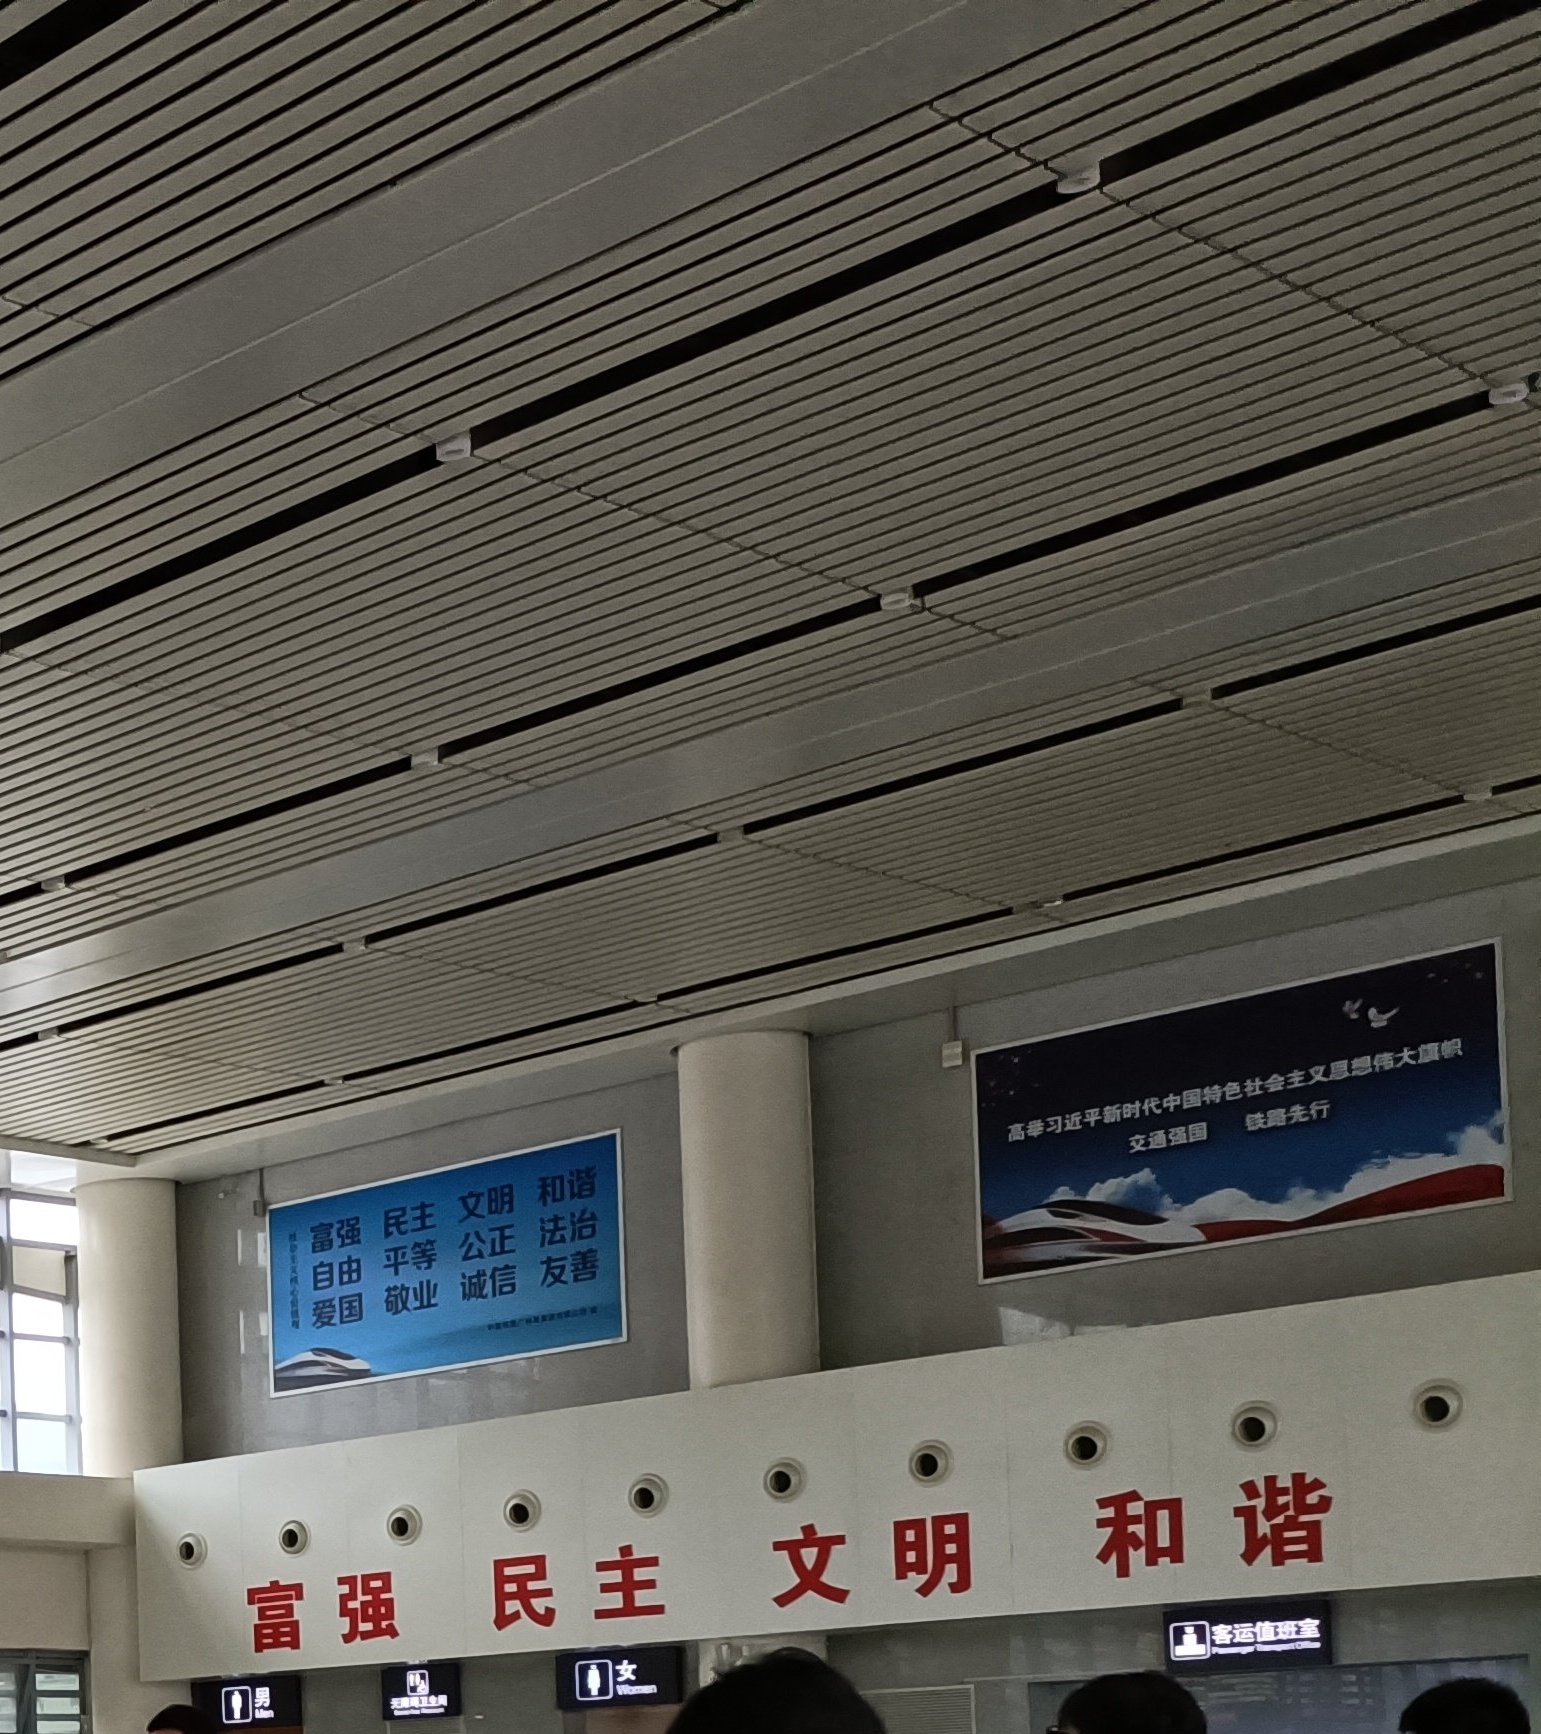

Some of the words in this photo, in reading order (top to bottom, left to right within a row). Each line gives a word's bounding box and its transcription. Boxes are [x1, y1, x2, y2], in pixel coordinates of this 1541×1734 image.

[1007, 1037, 1464, 1143] 高举习近平新时代中国特色社会主义思想伟大旗帜
[1128, 1122, 1208, 1153] 交通强国
[1245, 1101, 1330, 1131] 铁路先行
[310, 1215, 362, 1254] 富强
[383, 1201, 437, 1240] 民主
[458, 1183, 515, 1223] 文明
[537, 1165, 597, 1207] 和谐
[312, 1255, 362, 1291] 自由
[383, 1238, 437, 1276] 平等
[458, 1223, 515, 1262] 公正
[539, 1208, 598, 1248] 法治
[312, 1292, 363, 1329] 爱国
[384, 1279, 438, 1316] 敬业
[460, 1264, 516, 1302] 诚信
[539, 1248, 599, 1288] 友善
[246, 1570, 399, 1653] 富强
[492, 1544, 666, 1632] 民主
[771, 1512, 972, 1609] 文明
[1095, 1472, 1333, 1579] 和谐
[615, 1660, 637, 1682] 女
[1211, 1618, 1321, 1645] 客运值班室
[254, 1686, 271, 1708] 男
